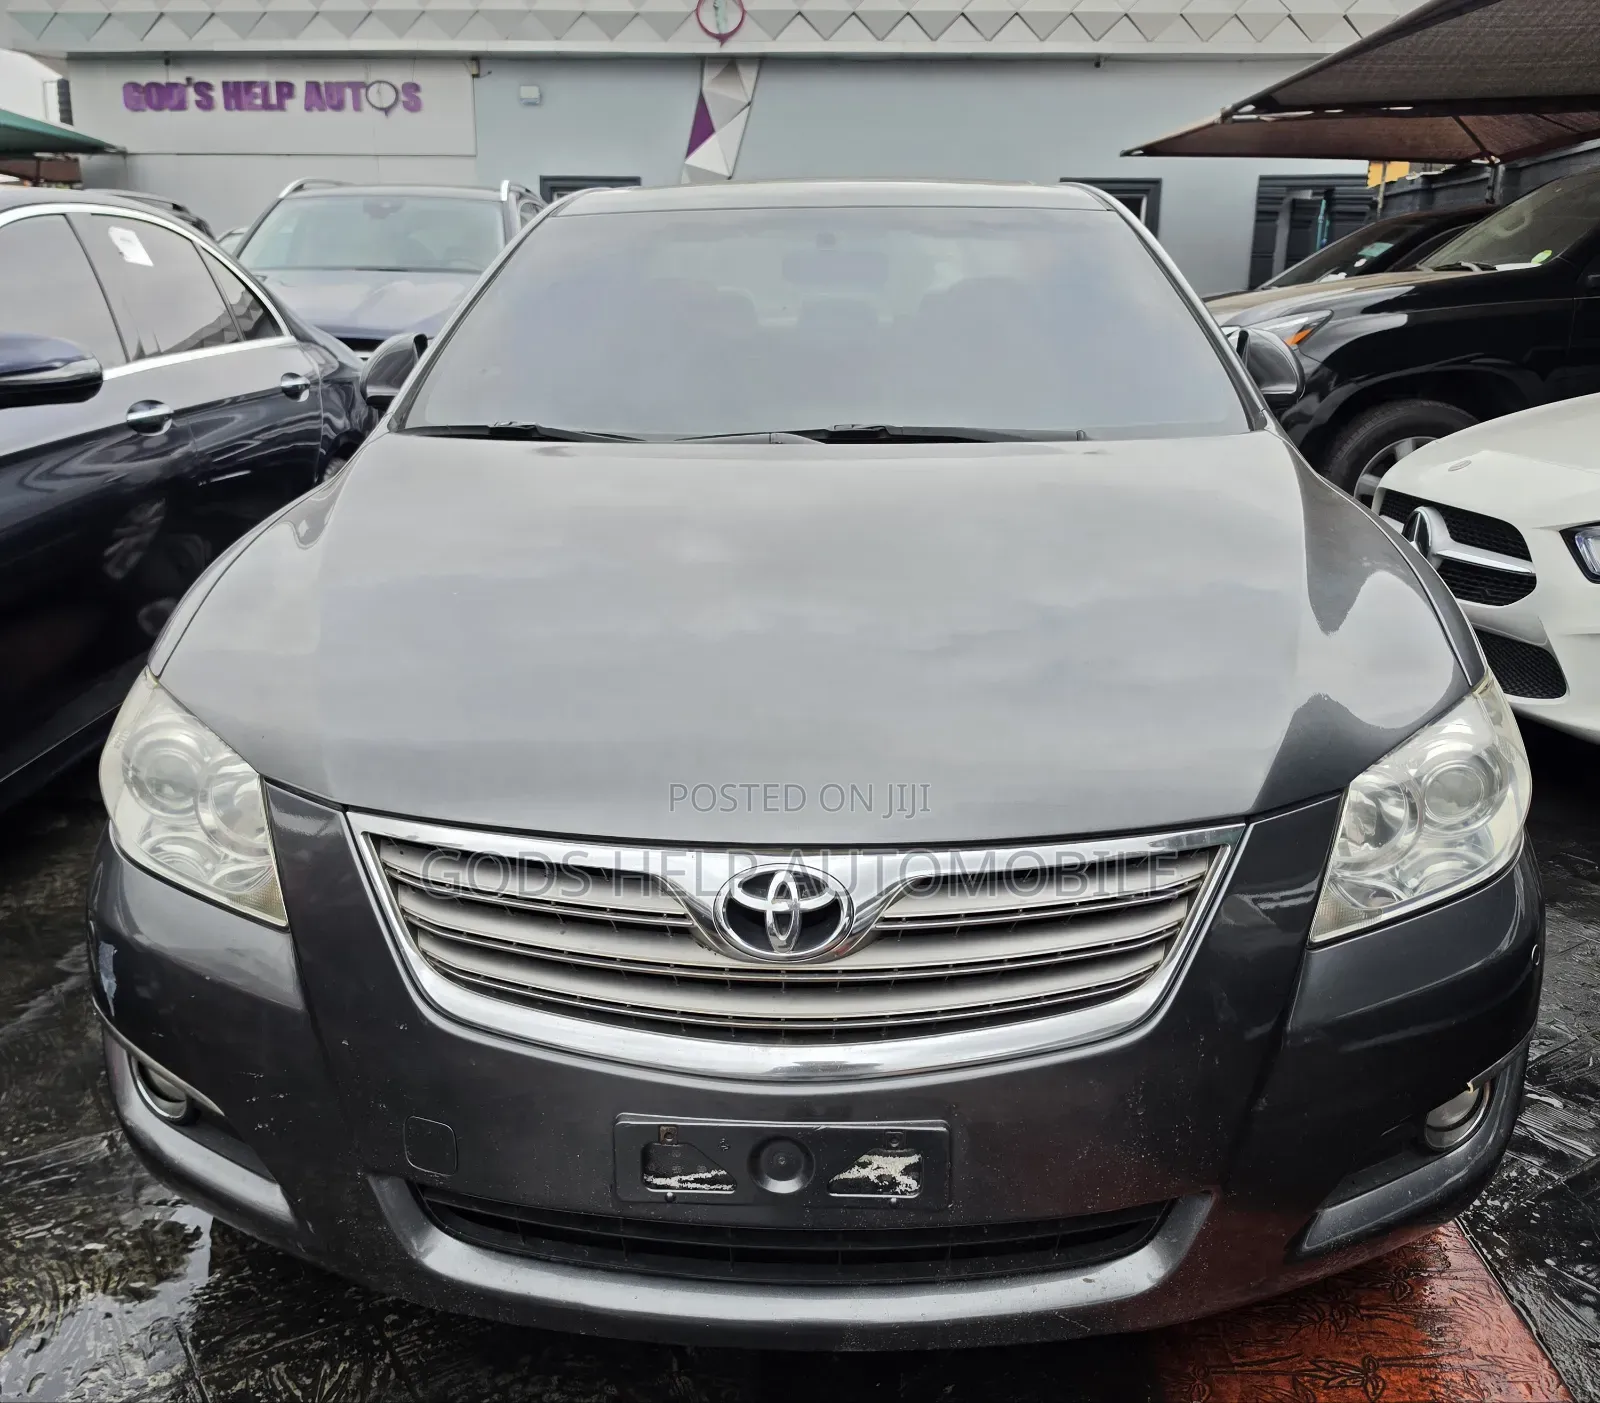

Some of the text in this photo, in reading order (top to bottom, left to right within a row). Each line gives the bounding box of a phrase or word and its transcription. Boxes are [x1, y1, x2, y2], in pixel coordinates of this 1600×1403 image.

[123, 77, 422, 116] GOD'S HELP AUTOS
